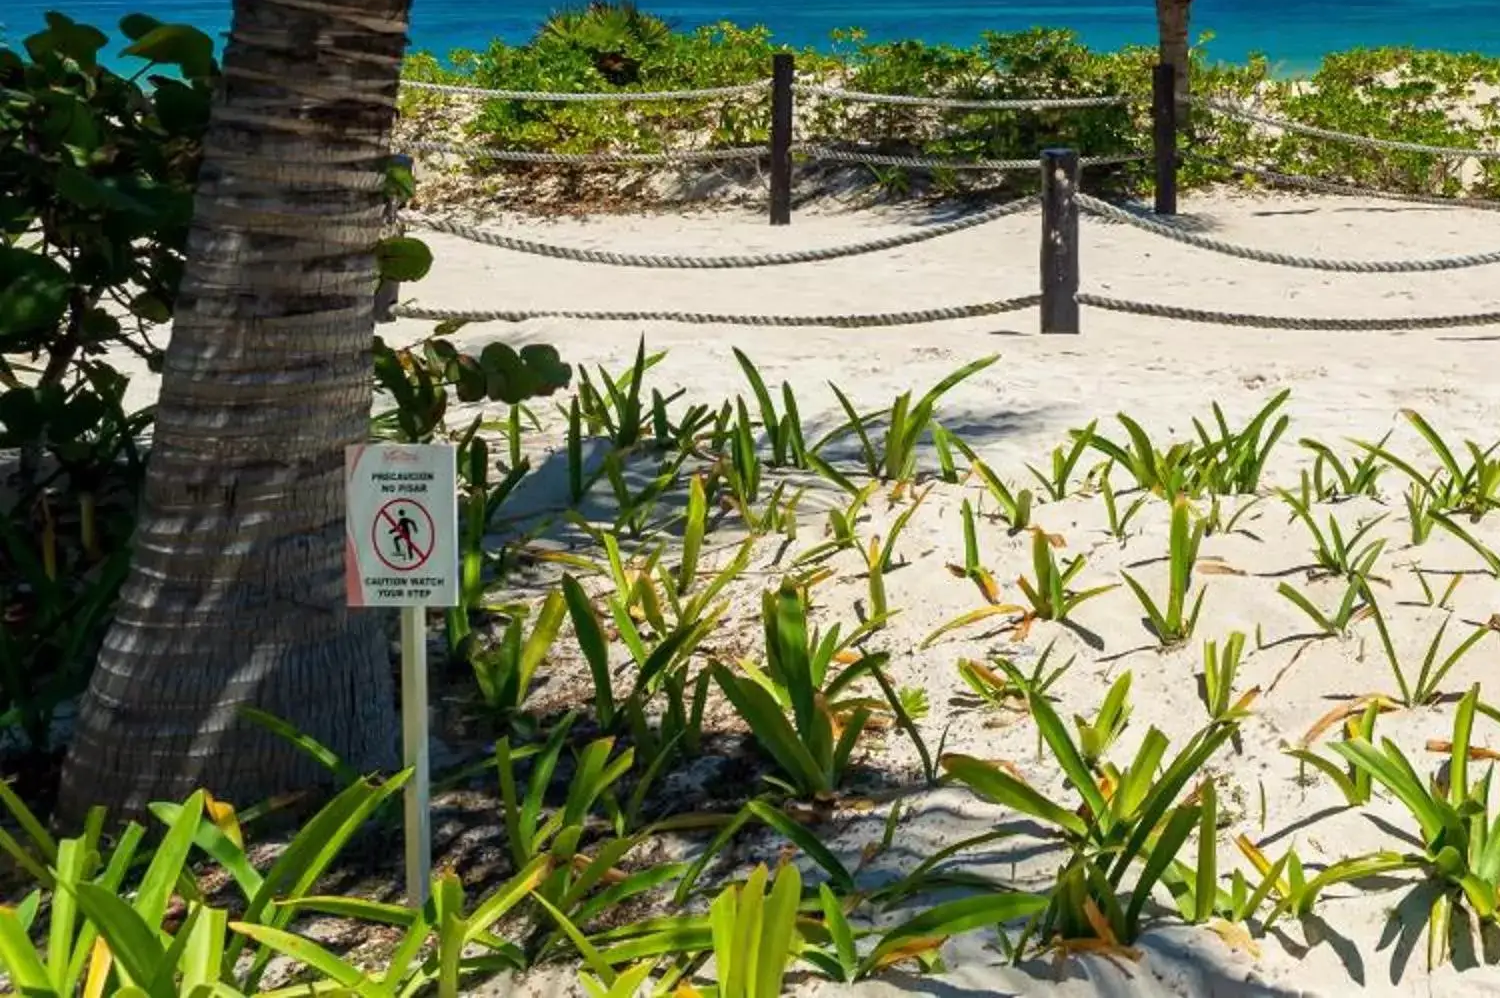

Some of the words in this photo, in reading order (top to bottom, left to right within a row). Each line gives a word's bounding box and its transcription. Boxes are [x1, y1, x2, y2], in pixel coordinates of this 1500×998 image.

[381, 484, 395, 493] NO
[398, 484, 428, 492] PISAR
[365, 577, 407, 585] CAUTION
[410, 577, 445, 586] WATCH
[378, 589, 404, 598] YOUR
[407, 589, 432, 597] STEP
